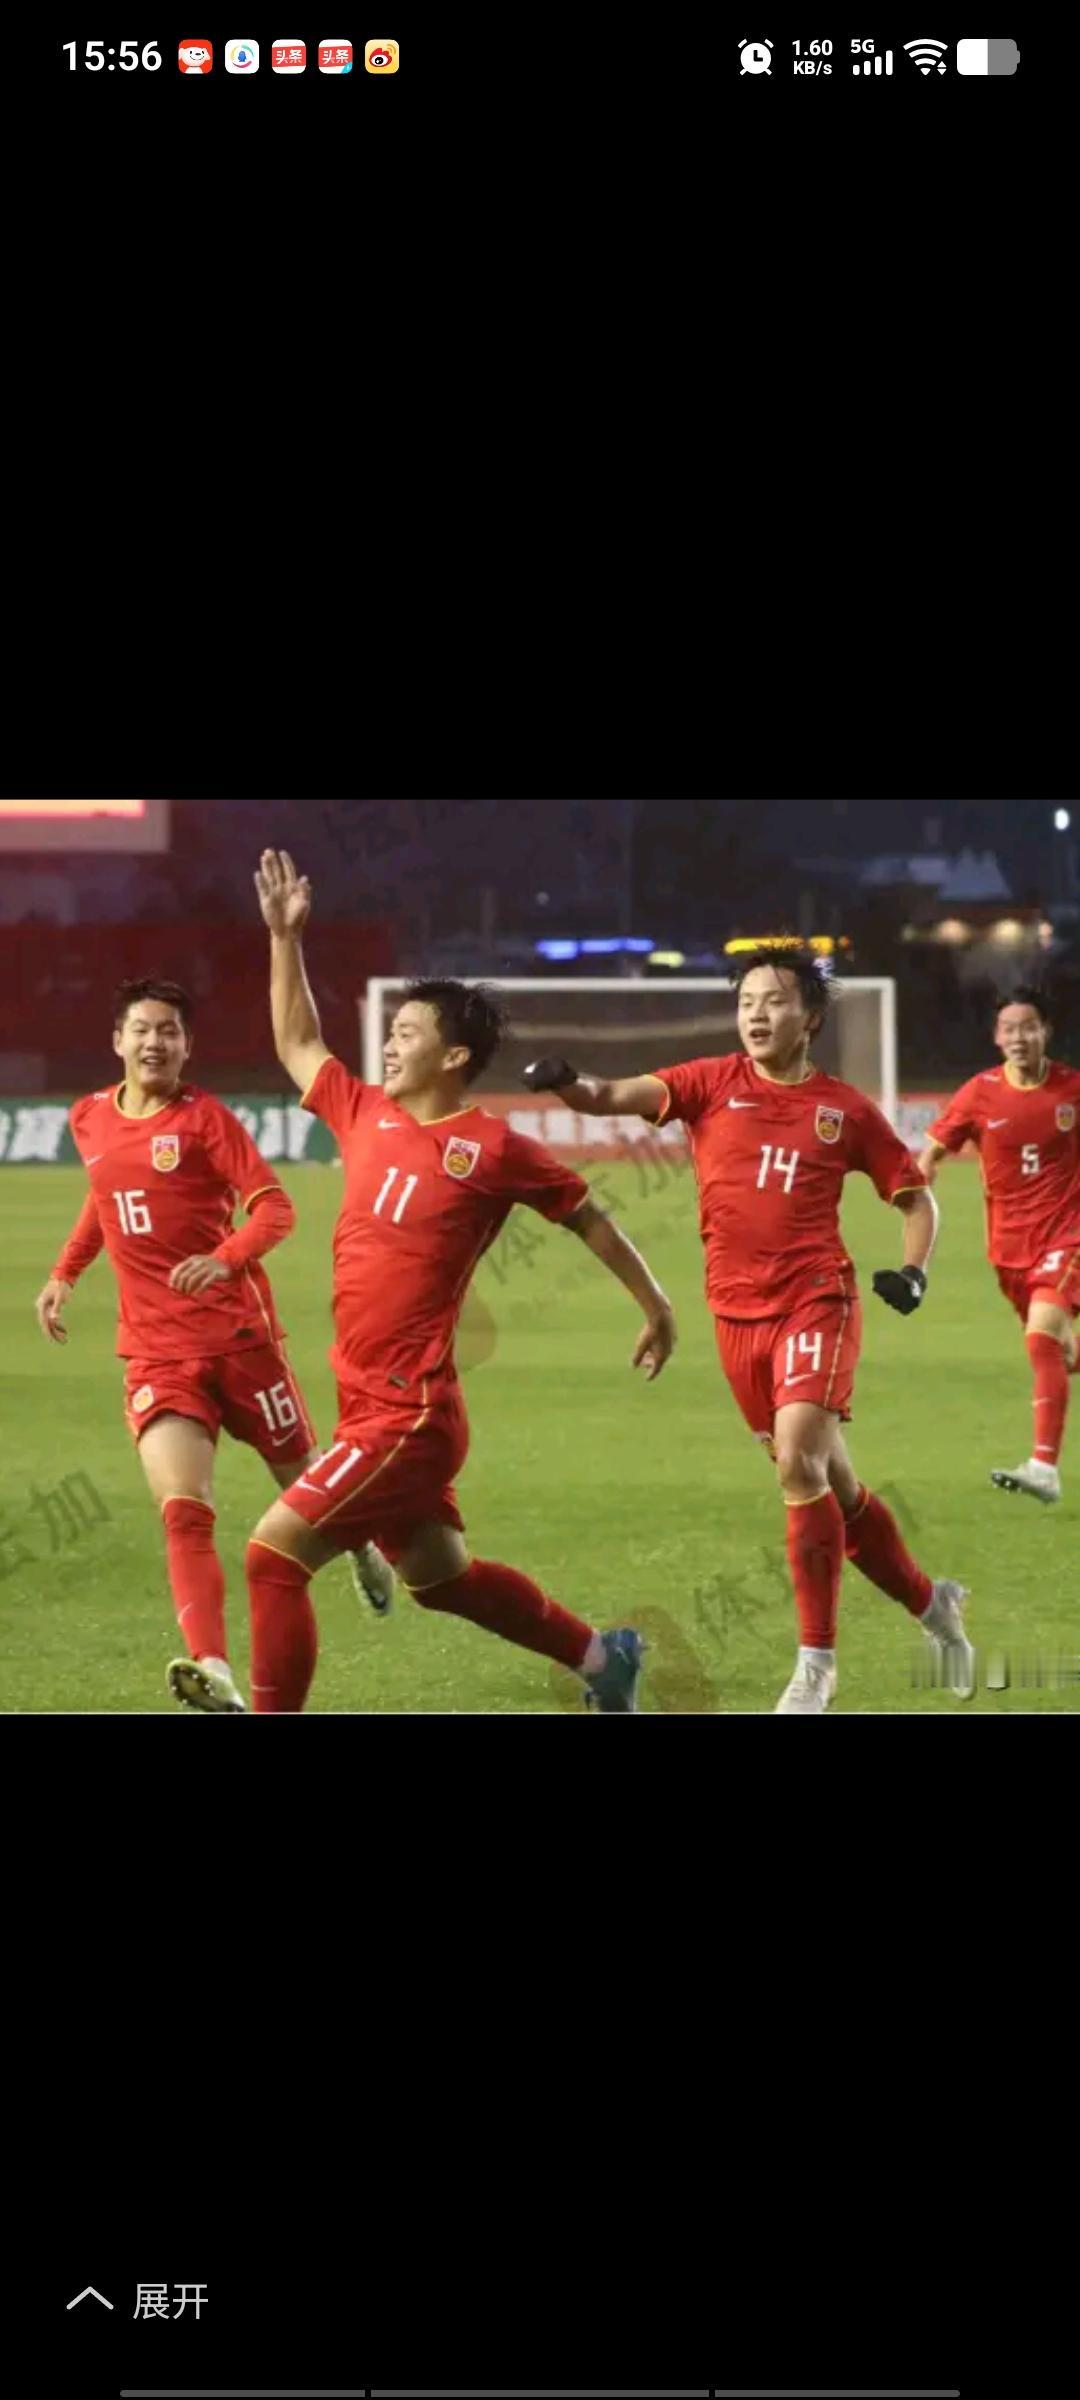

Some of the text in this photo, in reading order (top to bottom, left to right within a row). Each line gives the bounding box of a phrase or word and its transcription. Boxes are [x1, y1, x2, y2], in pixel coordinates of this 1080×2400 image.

[62, 40, 163, 72] 15:56
[276, 49, 302, 64] 头条
[322, 49, 349, 64] 头条
[791, 39, 833, 56] 1.60
[850, 39, 875, 54] 5G
[793, 61, 833, 76] KB/s
[757, 1145, 800, 1193] 14
[1021, 1144, 1039, 1174] 5
[372, 1166, 419, 1224] 11
[113, 1189, 152, 1236] 16
[785, 1331, 823, 1374] 14
[255, 1381, 298, 1430] 16
[307, 1441, 363, 1488] 11
[132, 2283, 209, 2320] 展开
